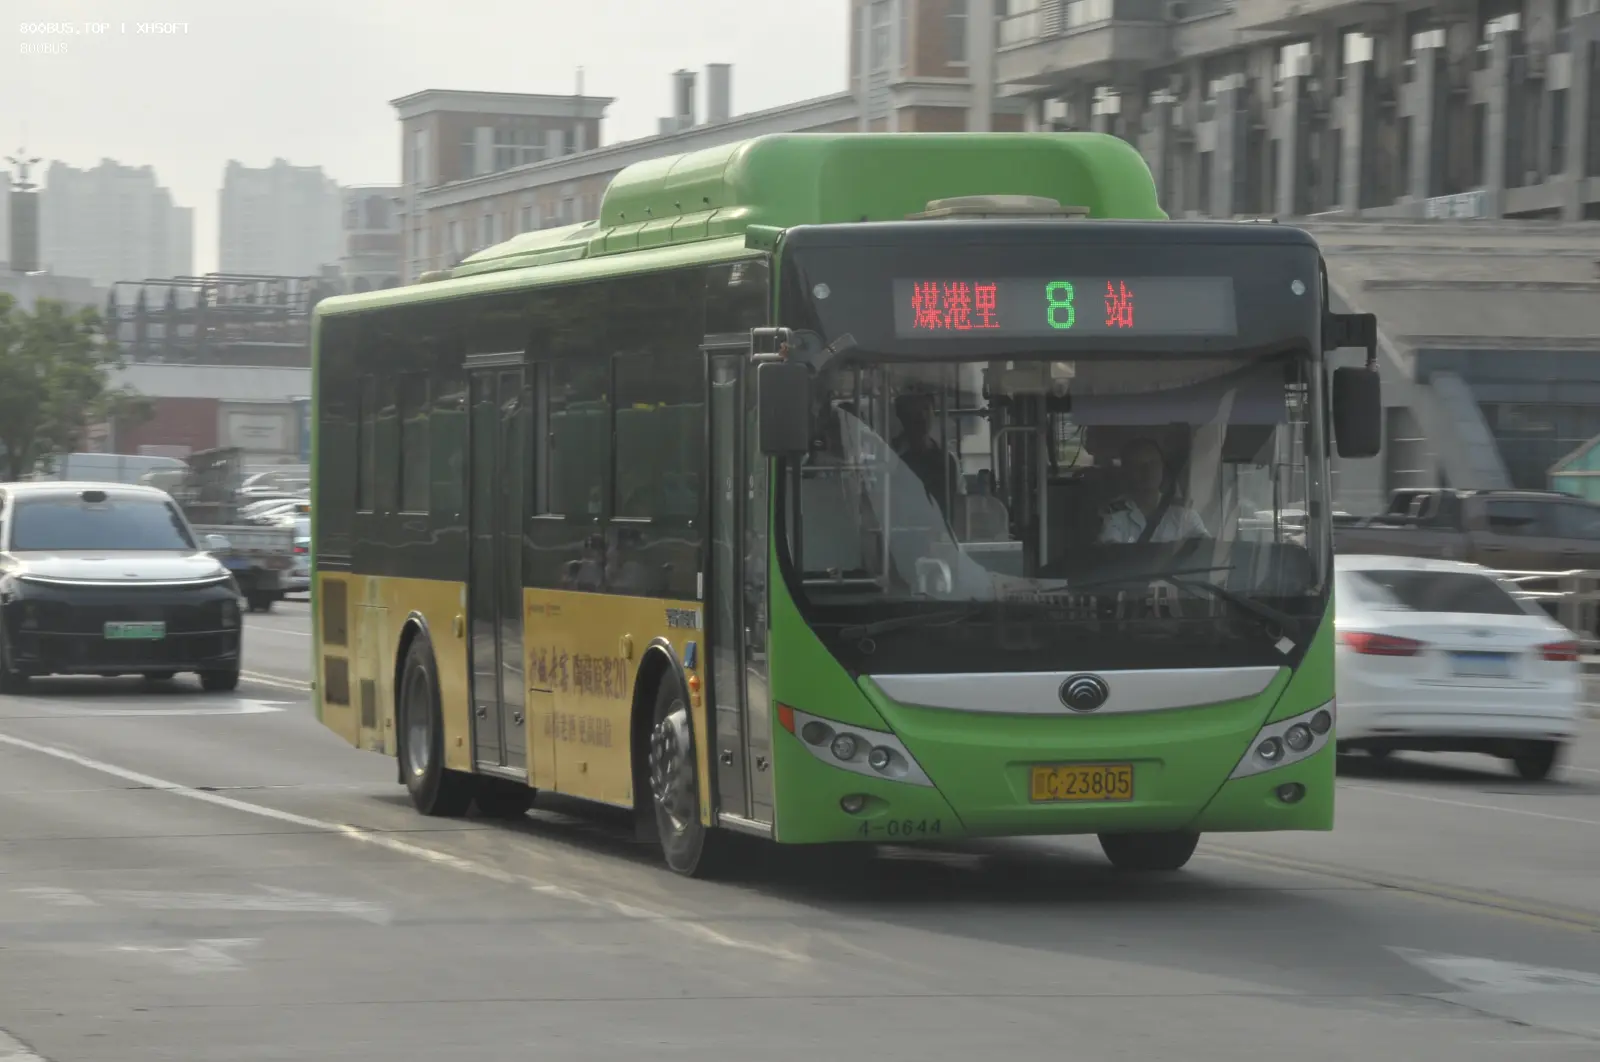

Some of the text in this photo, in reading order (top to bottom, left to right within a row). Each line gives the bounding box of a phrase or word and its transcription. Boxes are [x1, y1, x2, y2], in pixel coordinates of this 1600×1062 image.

[911, 279, 1134, 330] 煤港里 8 站
[858, 818, 942, 838] 4-0644
